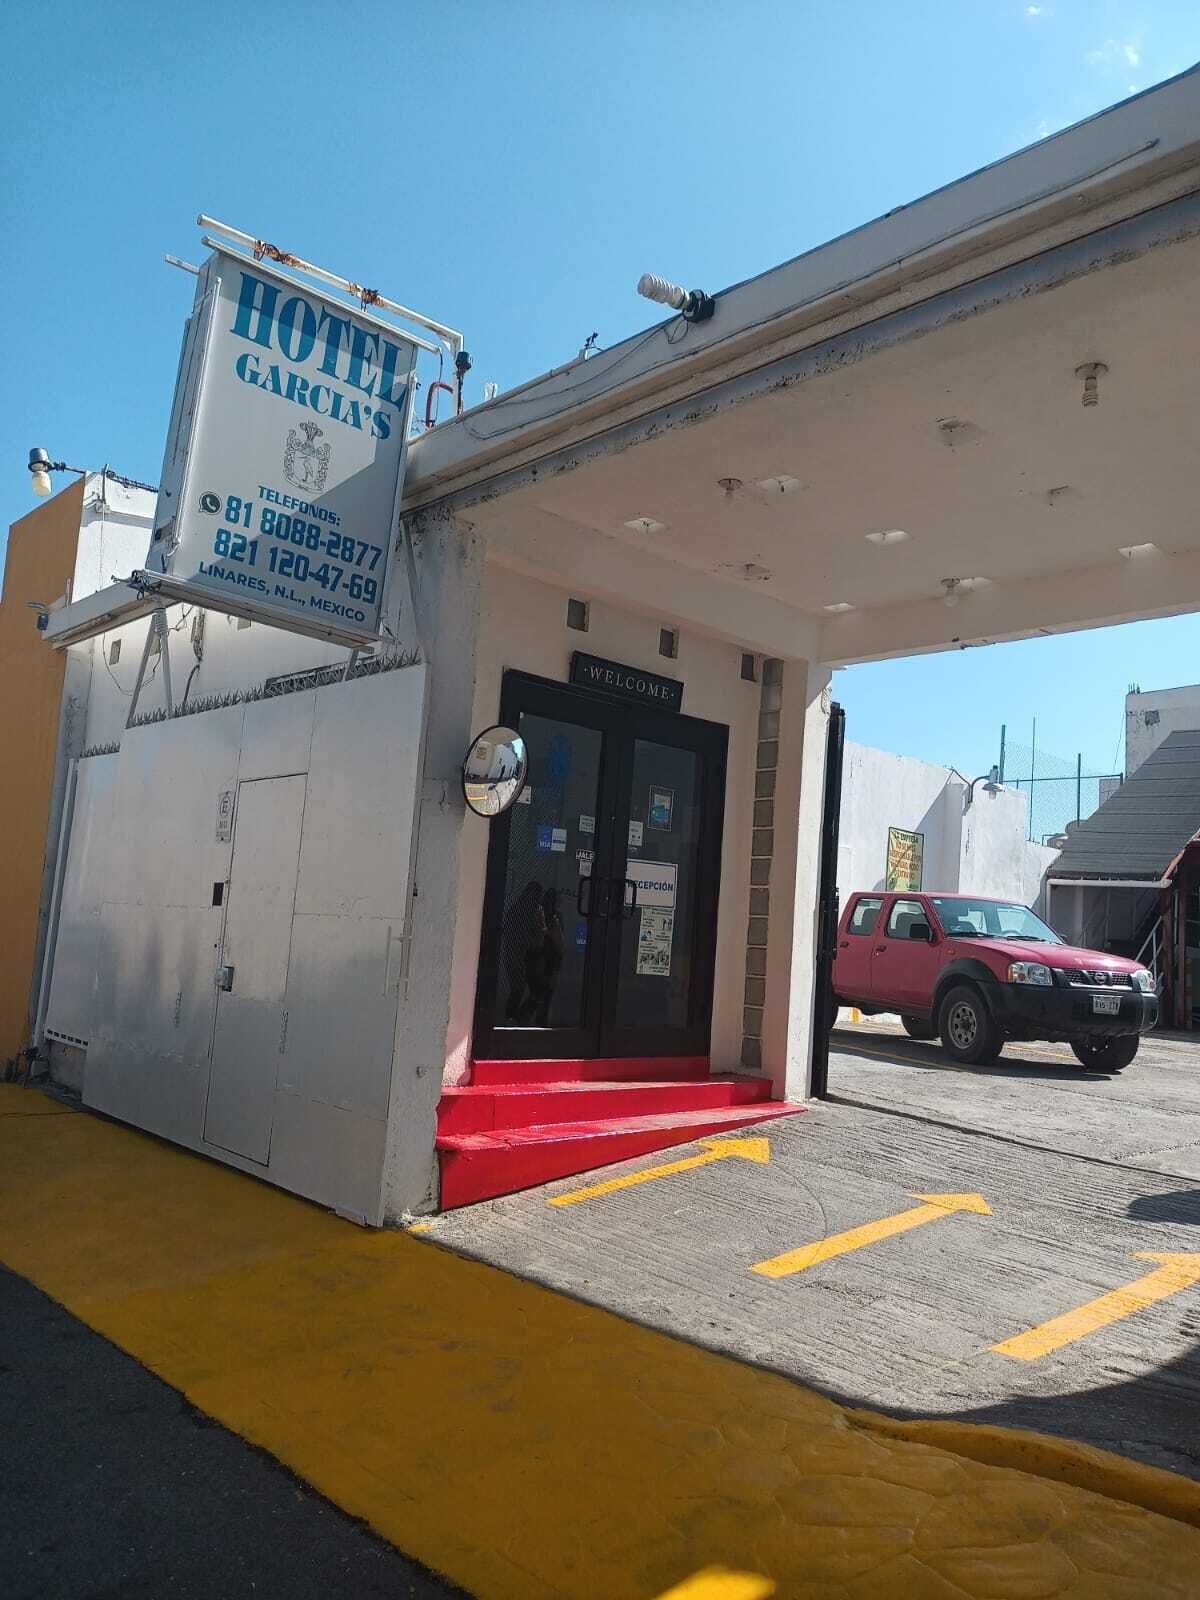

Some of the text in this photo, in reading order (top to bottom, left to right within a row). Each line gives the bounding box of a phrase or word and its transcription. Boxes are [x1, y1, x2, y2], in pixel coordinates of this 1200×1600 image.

[230, 272, 408, 412] HOTEL
[235, 353, 391, 439] GARCIA'S
[225, 495, 383, 571] 81 8088-2877
[258, 485, 341, 526] TELEFONOS:
[199, 561, 270, 596] LINARES,
[309, 596, 366, 622] MEXICO
[213, 528, 378, 604] 821 120-47-69
[590, 664, 670, 701] WELCOME
